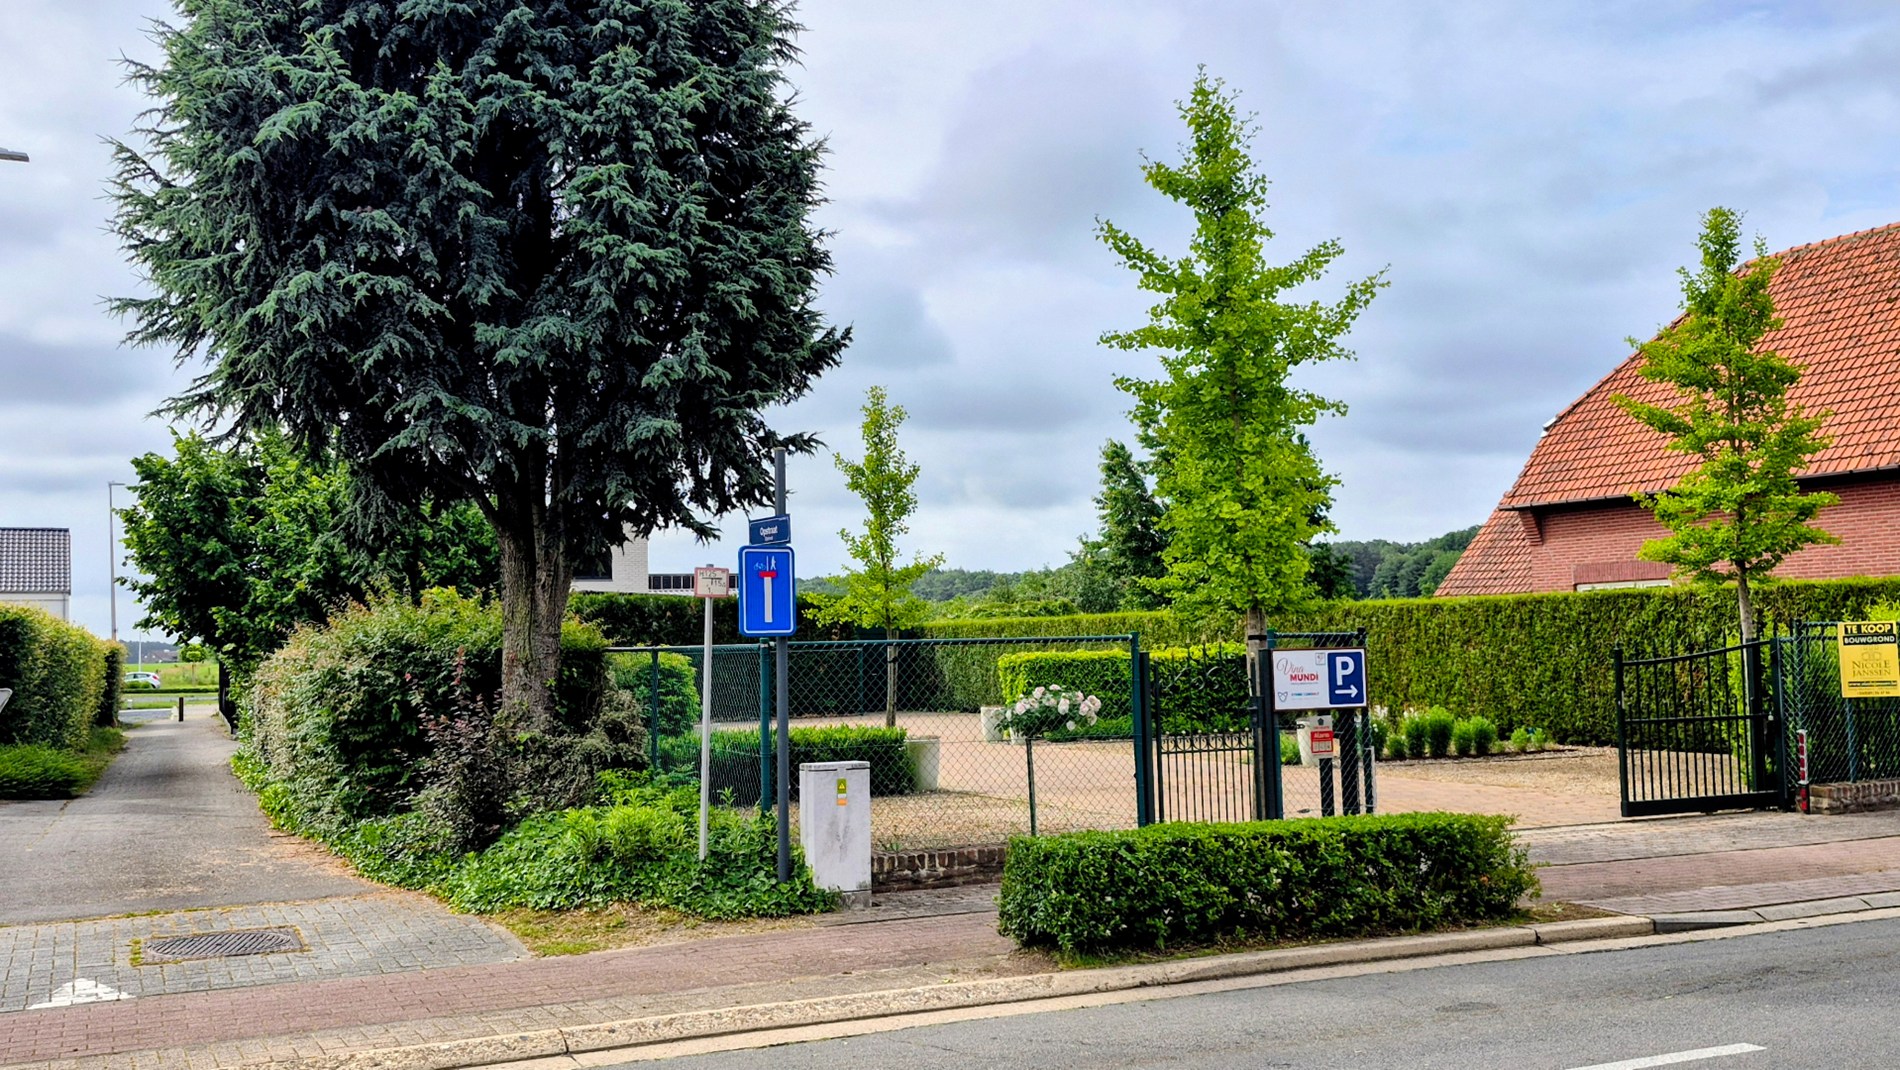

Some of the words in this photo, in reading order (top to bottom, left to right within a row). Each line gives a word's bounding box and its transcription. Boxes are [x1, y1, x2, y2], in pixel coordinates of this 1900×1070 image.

[1846, 624, 1858, 634] TE
[1861, 623, 1891, 634] KOOP
[1844, 636, 1895, 644] BOUWGROND
[1852, 660, 1891, 669] NICOLE
[1336, 656, 1355, 686] P
[1852, 669, 1891, 678] JANSSEN
